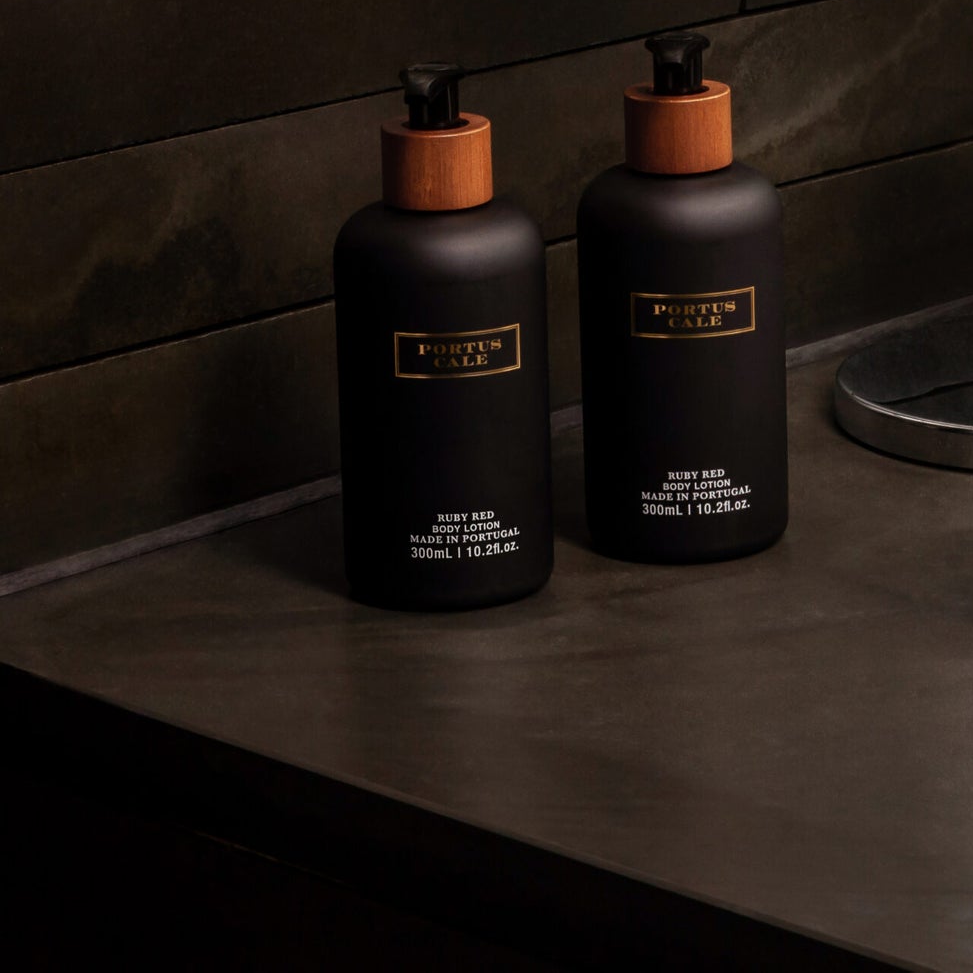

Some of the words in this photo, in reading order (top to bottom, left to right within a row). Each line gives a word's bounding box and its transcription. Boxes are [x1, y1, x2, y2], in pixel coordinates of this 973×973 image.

[653, 300, 736, 315] PORTUS
[668, 315, 722, 328] CALE
[417, 338, 502, 355] PORTUS
[433, 354, 488, 367] CALE
[667, 471, 698, 480] RUBY
[702, 468, 725, 479] RED
[663, 482, 691, 491] BODY
[694, 479, 731, 490] LOTION
[641, 491, 674, 501] MADE
[676, 492, 689, 501] IN
[692, 485, 751, 500] PORTUGAL
[437, 513, 468, 522] RUBY
[472, 510, 495, 521] RED
[642, 503, 683, 516] 300mL
[432, 524, 461, 533] BODY
[464, 520, 500, 533] LOTION
[410, 534, 443, 544] MADE
[446, 535, 459, 544] IN
[462, 527, 520, 543] PORTUGAL
[411, 547, 453, 559] 300mL
